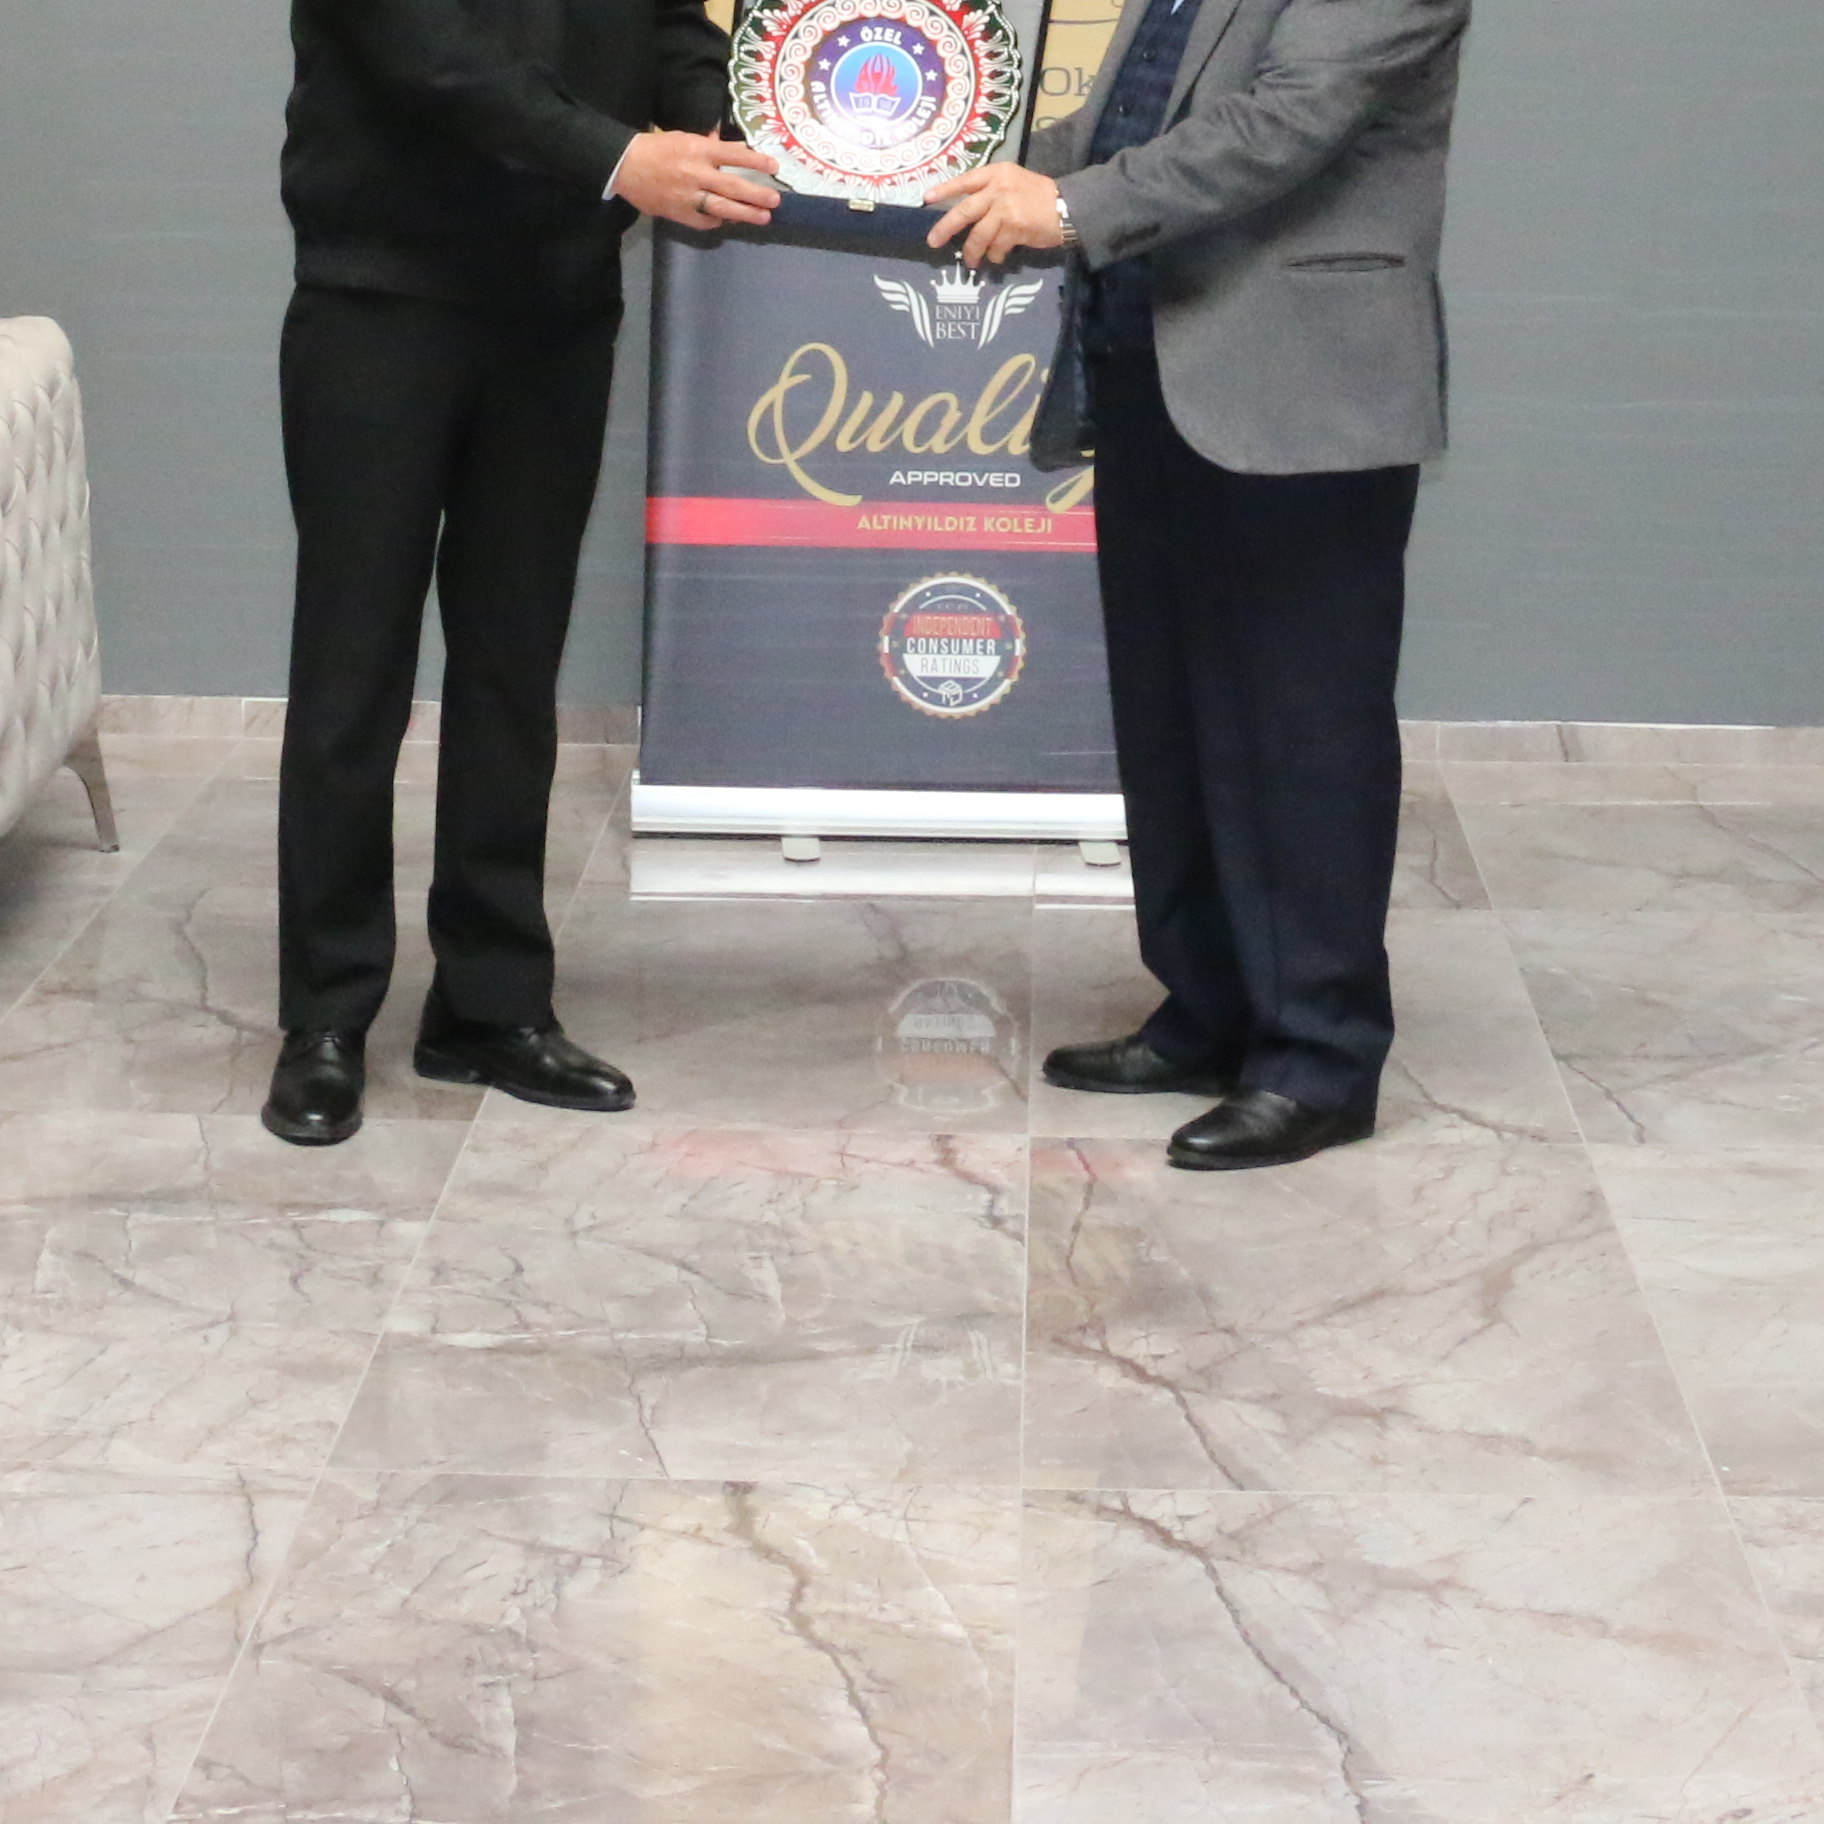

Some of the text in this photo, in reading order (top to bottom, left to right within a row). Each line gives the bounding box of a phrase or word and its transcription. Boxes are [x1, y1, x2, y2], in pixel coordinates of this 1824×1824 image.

[860, 26, 903, 46] ÖZEL
[936, 321, 981, 341] BEST
[889, 470, 1022, 488] APPROVED
[857, 514, 977, 533] ALTINYILDIZ
[912, 615, 994, 636] INDEPENDENT
[906, 637, 997, 656] CONSUMER
[920, 656, 980, 675] RATINGS
